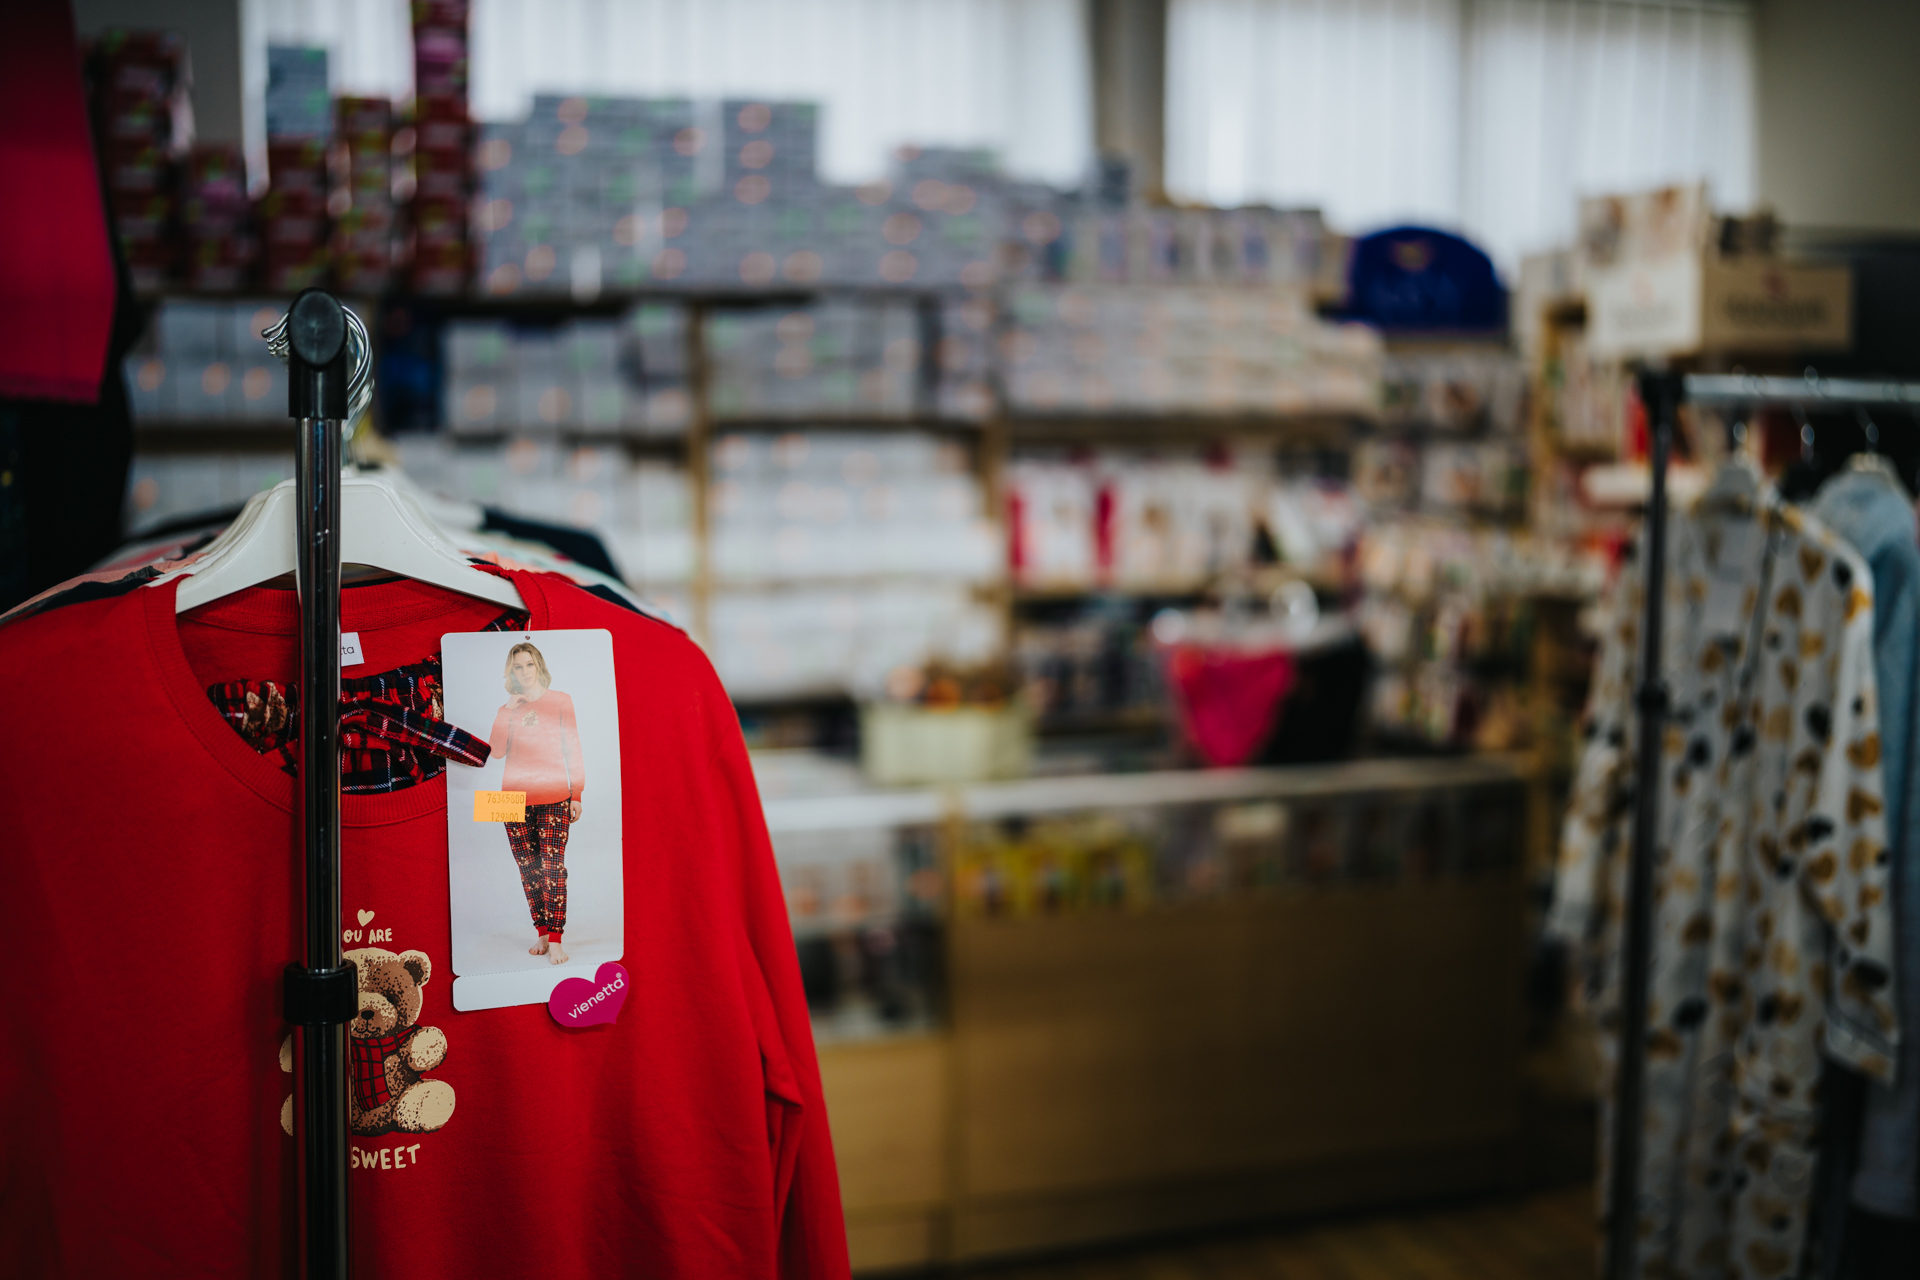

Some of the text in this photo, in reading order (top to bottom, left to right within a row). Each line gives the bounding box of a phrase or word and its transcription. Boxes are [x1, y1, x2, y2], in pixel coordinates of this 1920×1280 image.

[341, 646, 355, 655] ta
[343, 928, 393, 944] OU ARE
[568, 978, 625, 1018] vienetta
[352, 1143, 421, 1170] SWEET
